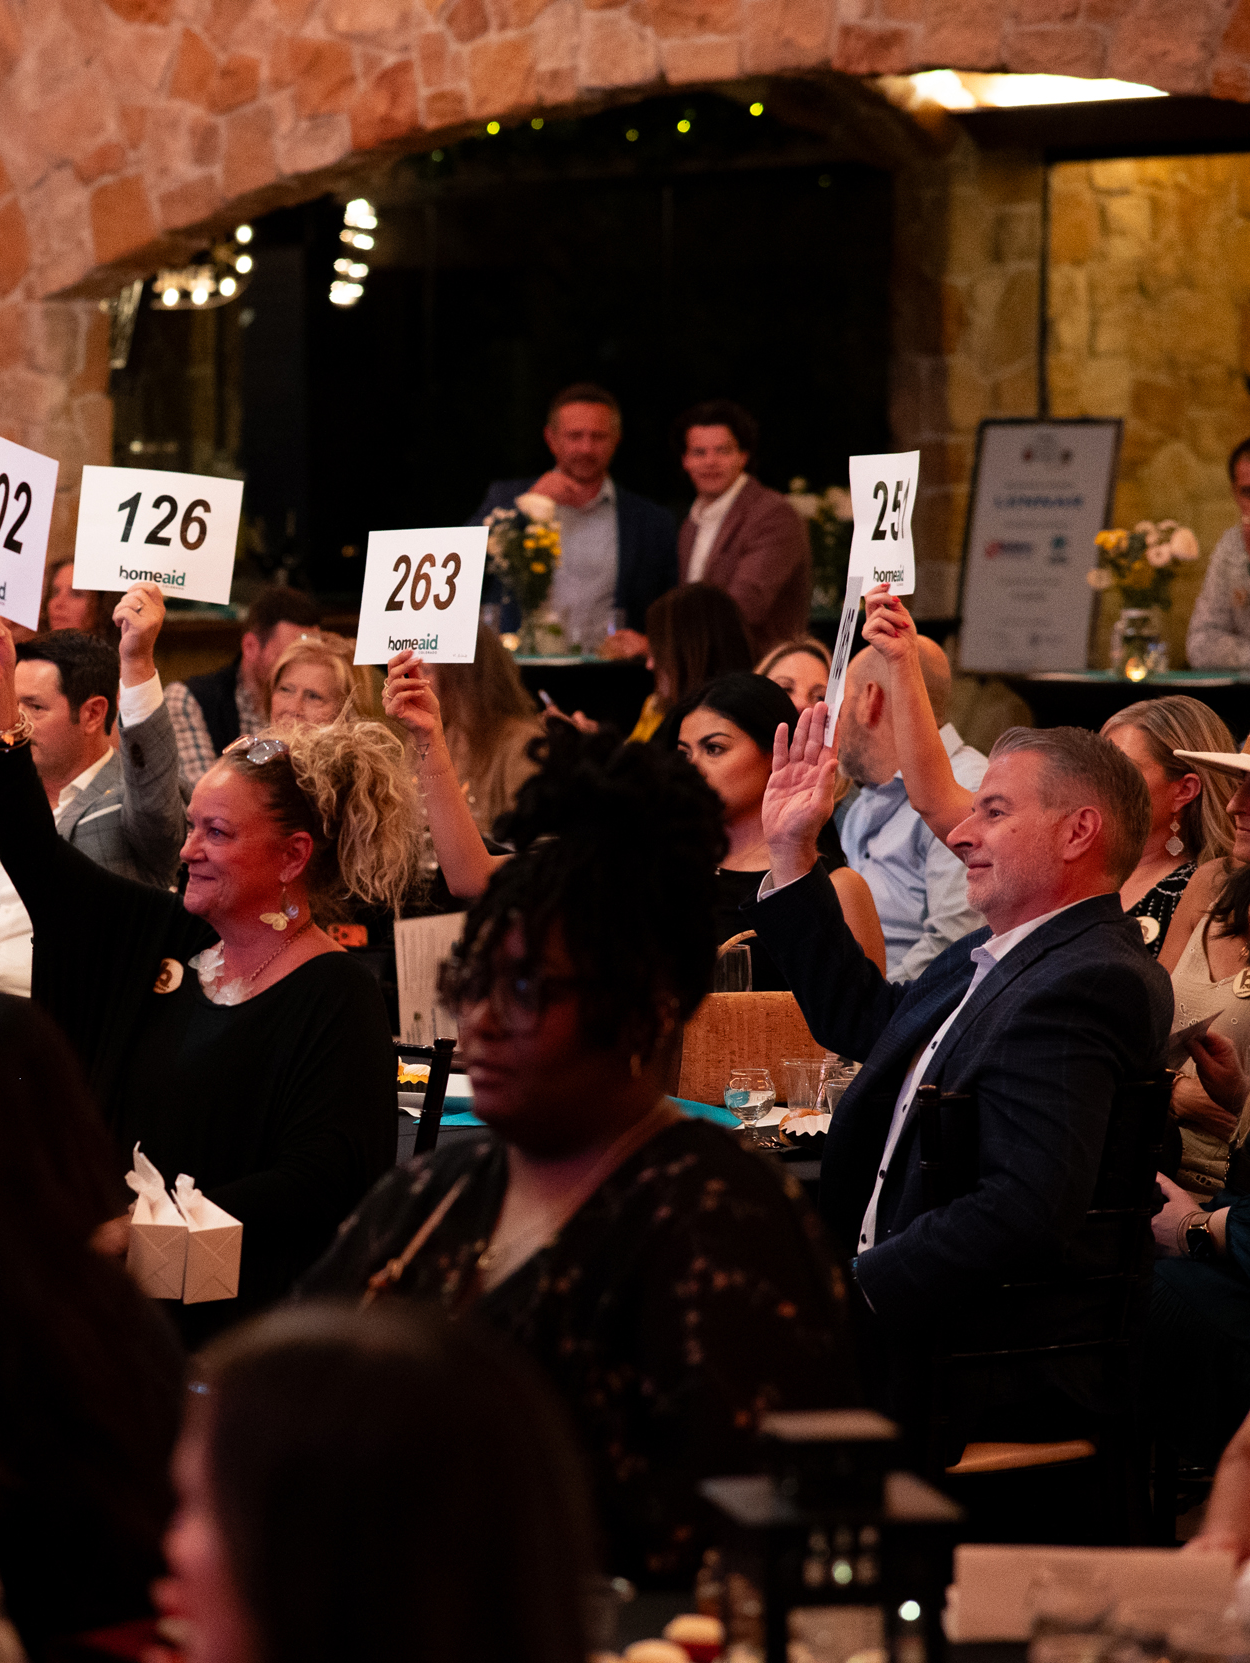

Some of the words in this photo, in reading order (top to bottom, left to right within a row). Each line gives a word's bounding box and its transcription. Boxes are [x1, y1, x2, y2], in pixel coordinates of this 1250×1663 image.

[117, 491, 212, 551] 126
[871, 477, 910, 541] 251
[119, 565, 186, 586] homeaid
[384, 552, 462, 612] 263
[388, 632, 439, 651] homeaid
